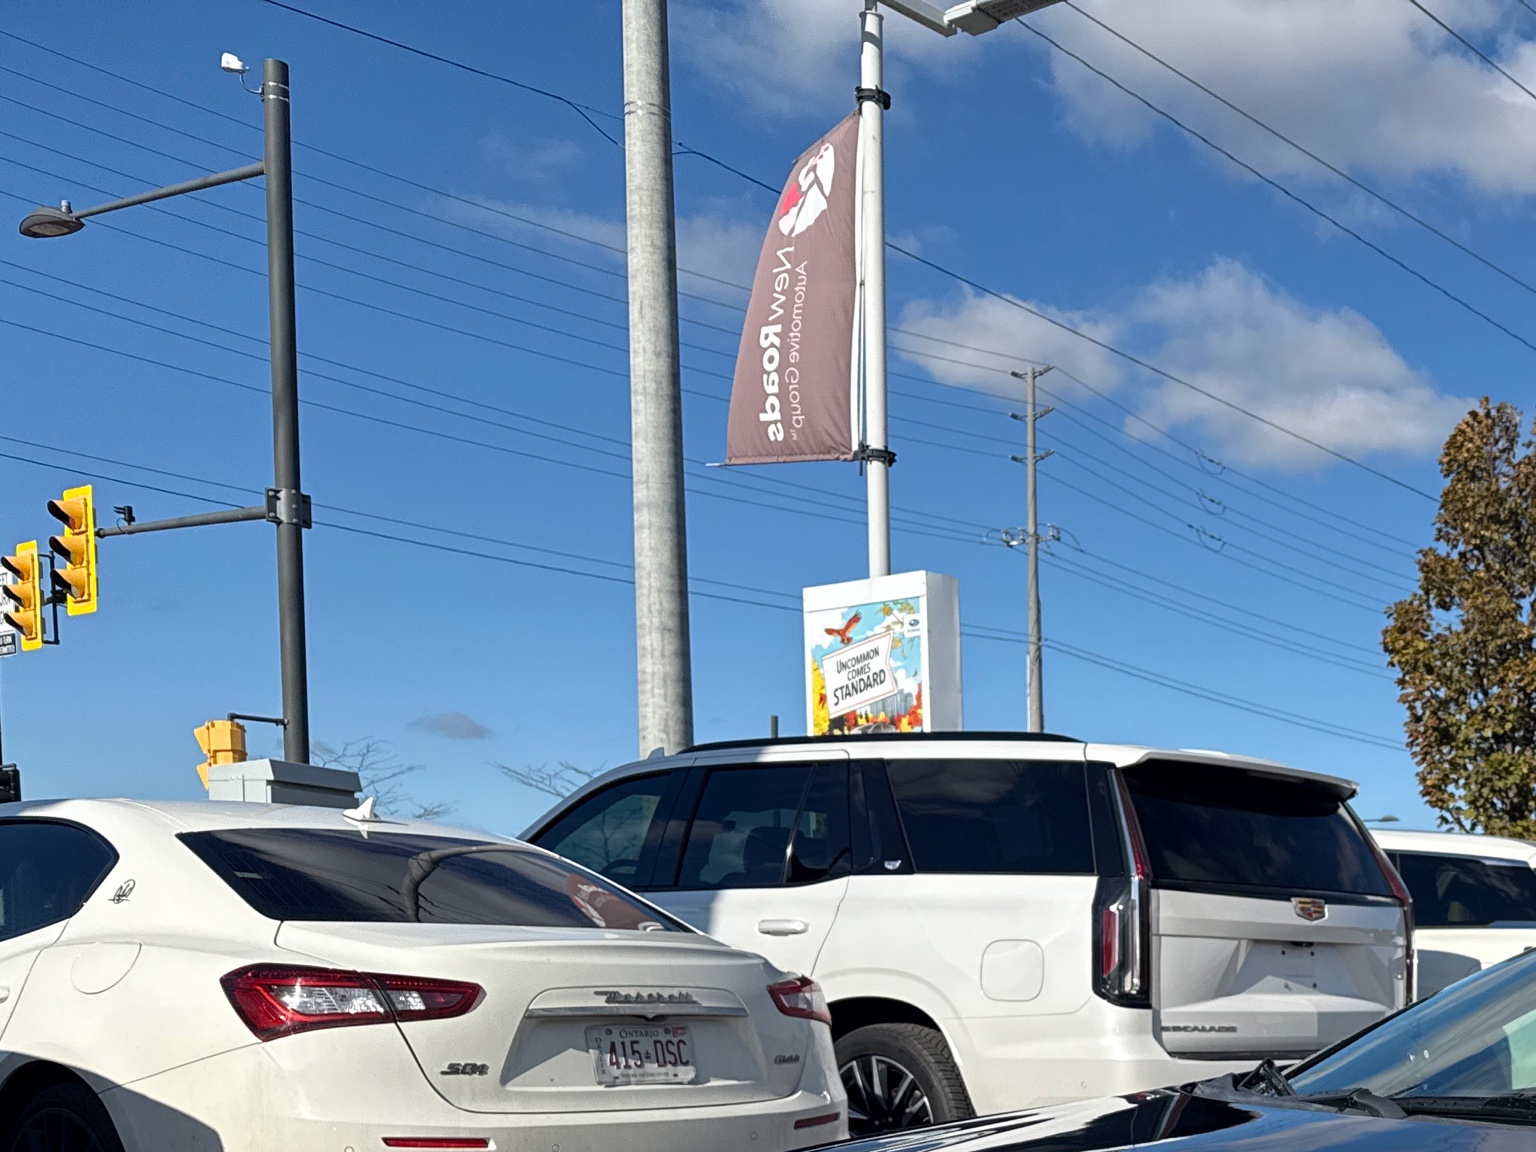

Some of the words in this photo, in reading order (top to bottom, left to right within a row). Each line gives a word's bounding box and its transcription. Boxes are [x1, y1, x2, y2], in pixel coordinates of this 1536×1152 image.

[836, 646, 880, 674] UNCOMMON
[847, 662, 871, 681] COMES
[833, 668, 886, 706] STANDARD
[620, 1029, 659, 1039] ONTARIO
